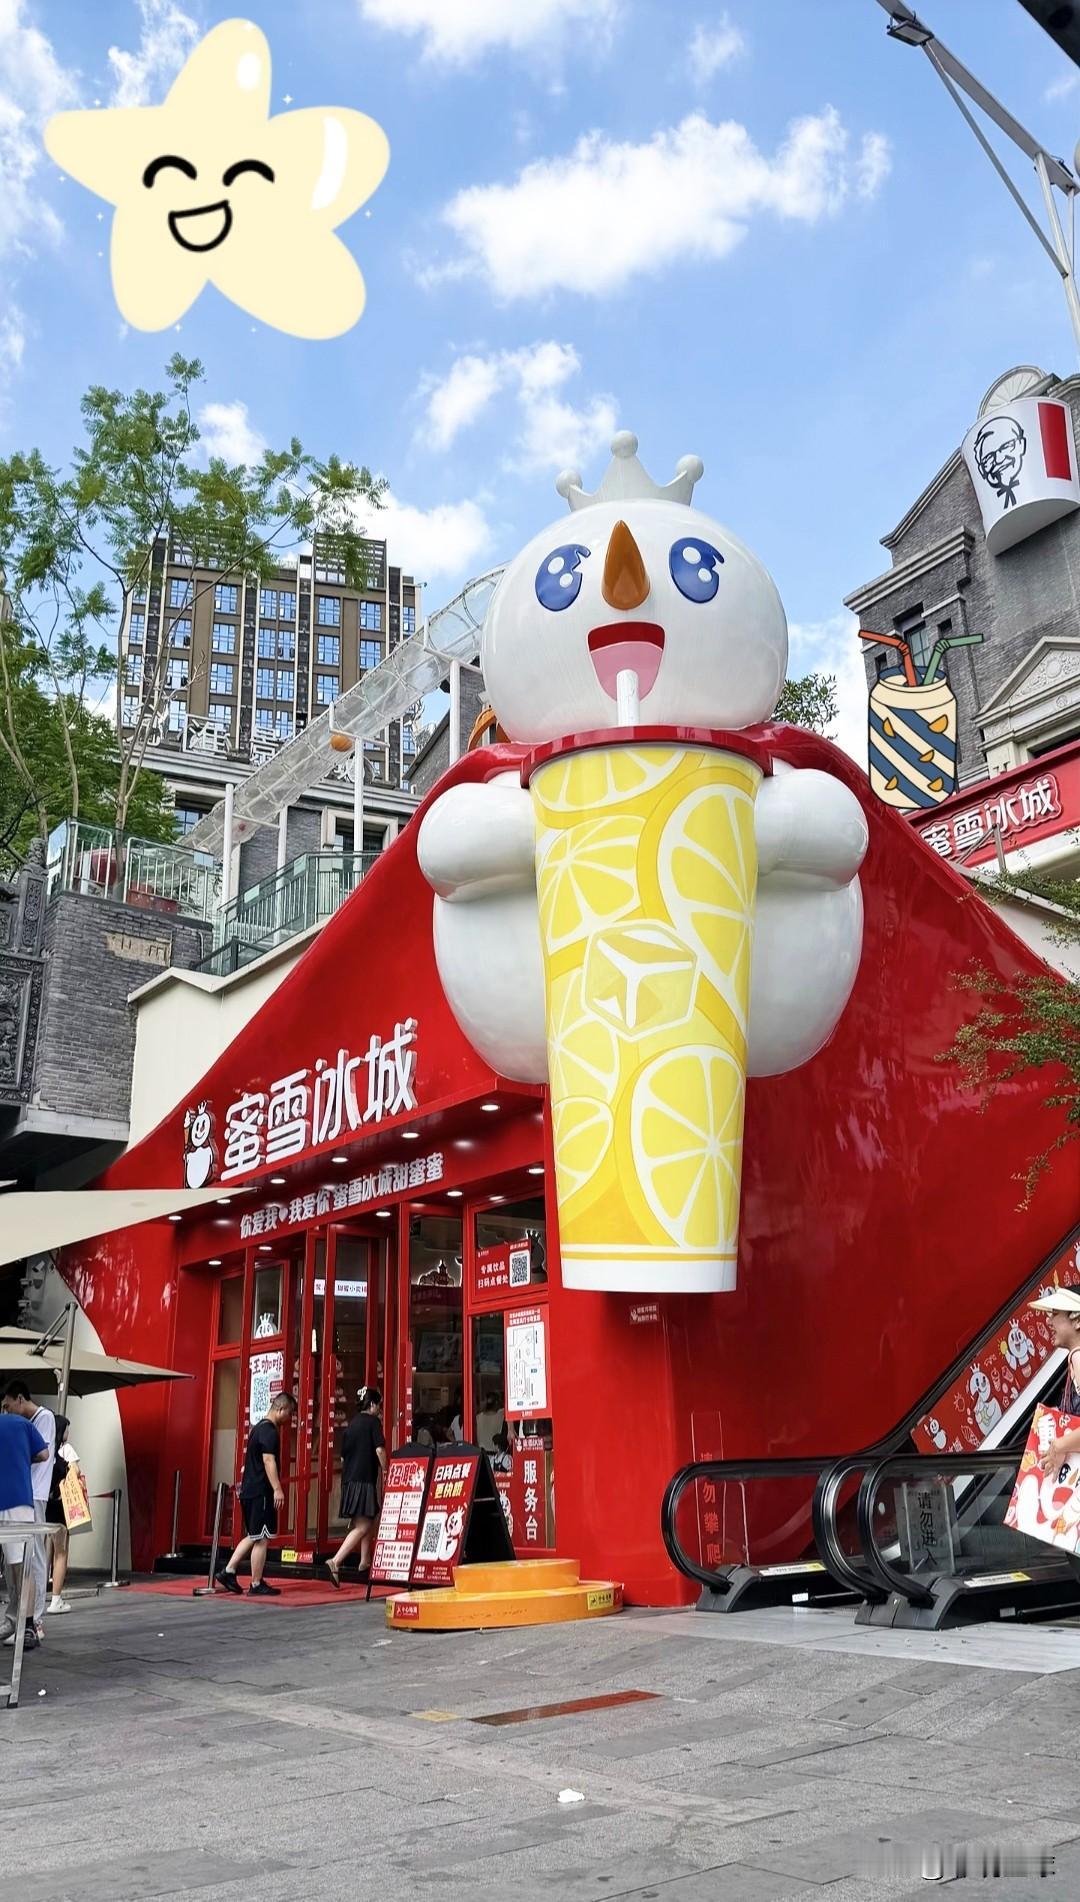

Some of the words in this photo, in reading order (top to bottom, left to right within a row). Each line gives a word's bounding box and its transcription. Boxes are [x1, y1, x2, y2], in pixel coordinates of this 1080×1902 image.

[220, 1017, 418, 1181] 蜜雪冰城
[240, 1206, 278, 1239] 你爱我
[288, 1189, 330, 1224] 我爱你
[332, 1152, 443, 1211] 蜜雪冰城甜蜜蜜
[250, 1354, 283, 1375] 王咖啡
[523, 1460, 539, 1541] 服务台
[918, 1491, 938, 1566] 请勿进入
